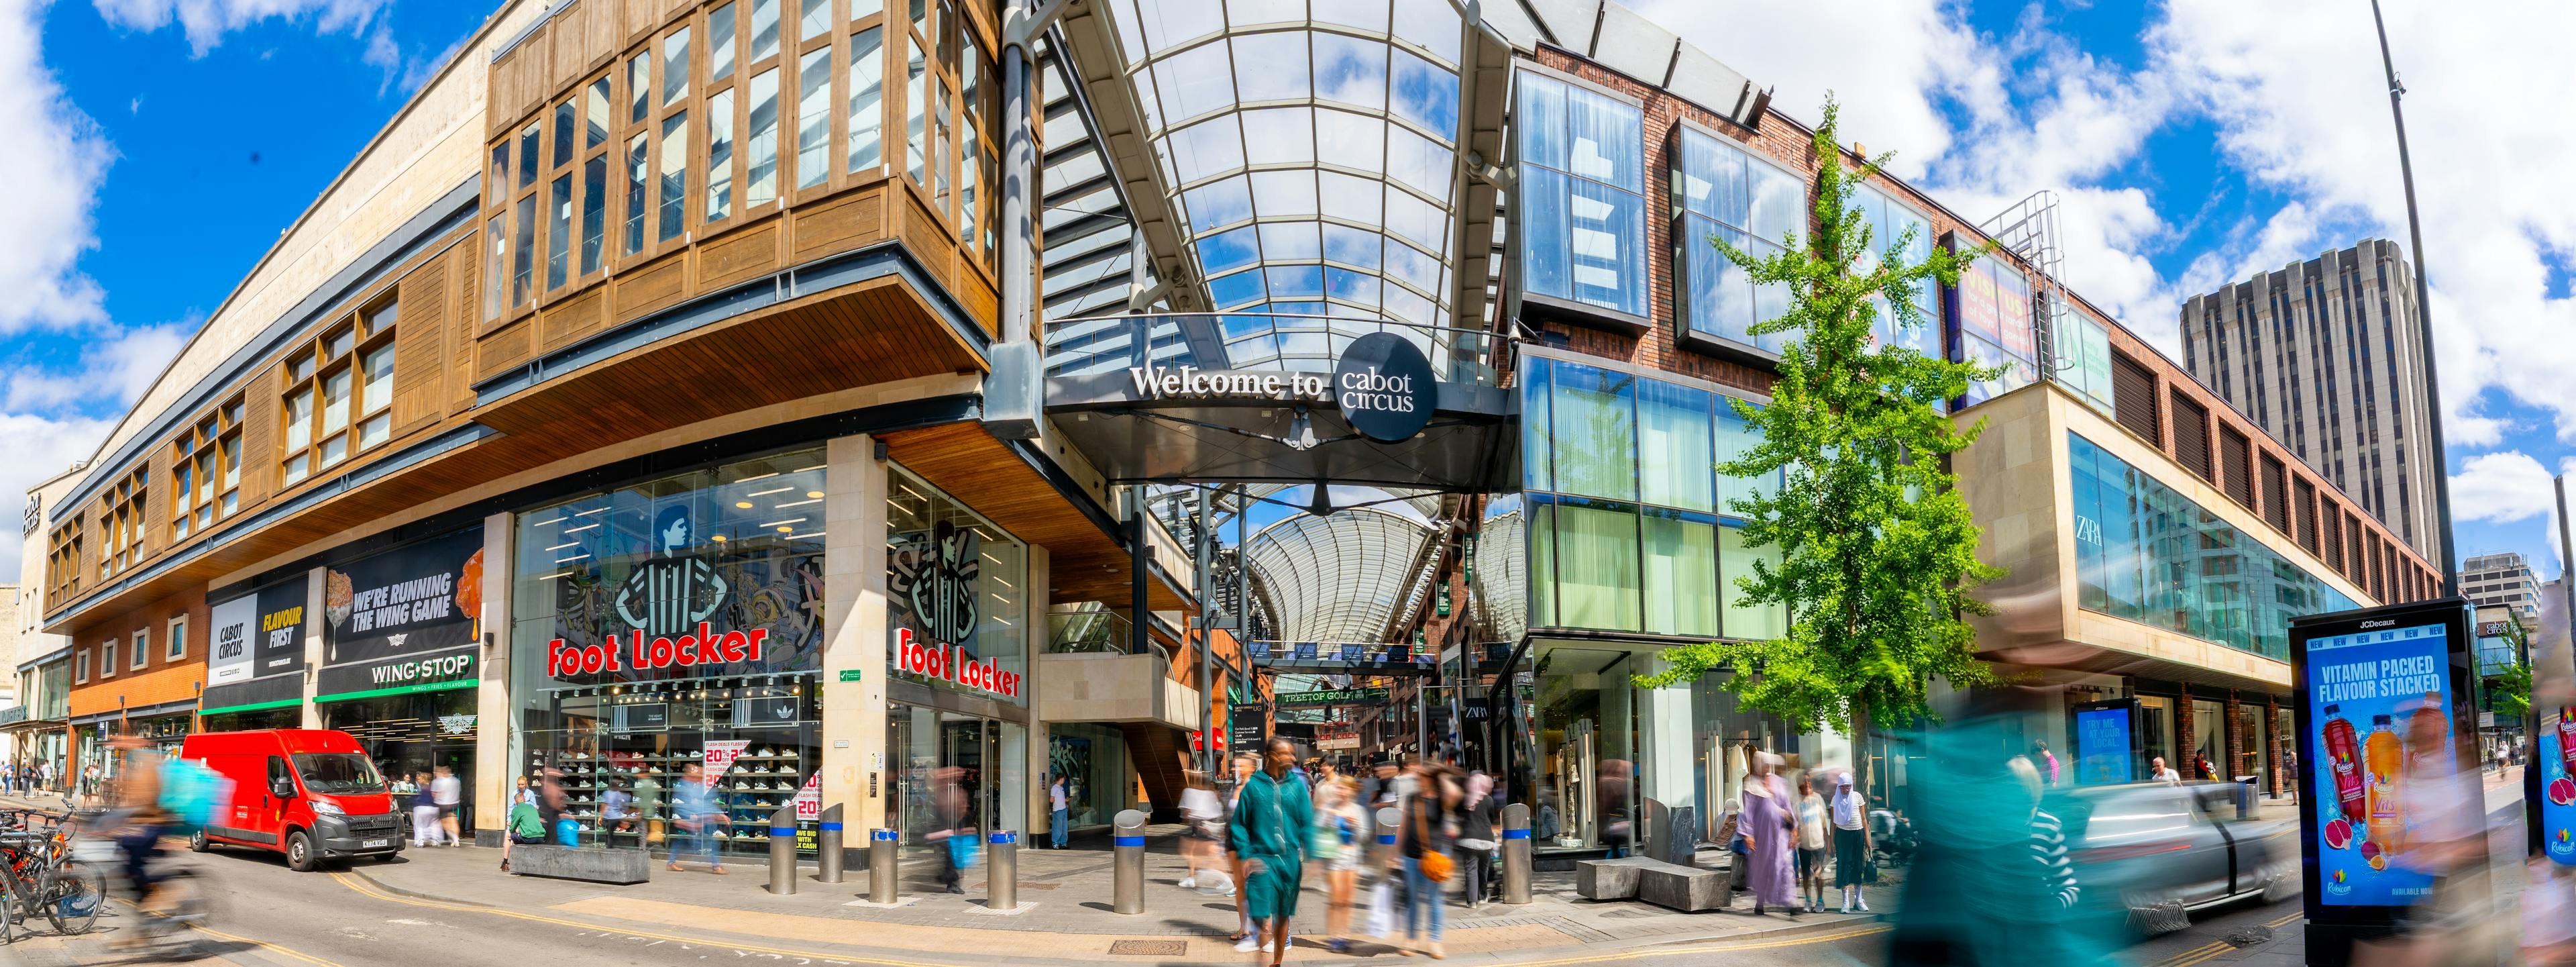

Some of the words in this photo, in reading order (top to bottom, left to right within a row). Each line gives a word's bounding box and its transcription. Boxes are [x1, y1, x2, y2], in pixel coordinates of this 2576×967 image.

[1968, 289, 1978, 302] for
[1980, 299, 1985, 307] a
[1986, 303, 2004, 319] gret
[2004, 295, 2023, 317] US
[1969, 307, 1978, 317] of
[1980, 312, 1994, 329] toys
[1129, 365, 1281, 396] Welcome
[1292, 370, 1323, 396] to
[1342, 366, 1413, 394] cabot
[1342, 391, 1414, 413] circus
[2076, 515, 2102, 547] ZARA
[354, 586, 389, 612] WE'RE
[390, 572, 451, 608] RUNNING
[262, 606, 302, 632] FLAVOUR
[353, 611, 374, 633] THE
[376, 603, 409, 629] WING
[412, 595, 451, 623] GAME
[2360, 619, 2395, 629] JCDecaux
[220, 623, 244, 643] CABOT
[2487, 621, 2508, 629] cabot
[269, 626, 293, 648] FIRST
[2310, 640, 2323, 649] NEW
[2333, 638, 2346, 646] NEW
[2357, 634, 2369, 644] NEW
[2380, 631, 2394, 641] NEW
[2404, 629, 2418, 638] NEW
[2429, 626, 2443, 635] NEW
[219, 640, 243, 660] CIRCUS
[548, 634, 622, 677] Foot
[633, 621, 769, 670] Locker
[894, 627, 952, 681] Foot
[955, 646, 1020, 698] Locker
[2322, 661, 2377, 684] VITAMIN
[2381, 655, 2434, 678] PACKED
[1285, 693, 1325, 703] TREETOP
[1327, 691, 1352, 701] GOLF
[2319, 680, 2376, 703] FLAVOUR
[2380, 674, 2440, 697] STACKED
[1466, 707, 1488, 718] ZARA
[2086, 719, 2100, 729] TRY
[2103, 718, 2114, 727] ME
[2089, 729, 2099, 739] AT
[2100, 727, 2120, 737] YOUR
[2561, 722, 2576, 732] Rubico
[2093, 738, 2120, 748] LOCAL.
[2563, 735, 2576, 748] Vi
[2337, 762, 2355, 772] Rubicon
[2339, 775, 2359, 790] Vits
[2373, 782, 2394, 792] Rubicon
[2373, 797, 2395, 812] Vits
[2327, 882, 2351, 894] Rubicon
[2392, 888, 2420, 896] AVAILABLE
[2420, 887, 2433, 895] NOW
